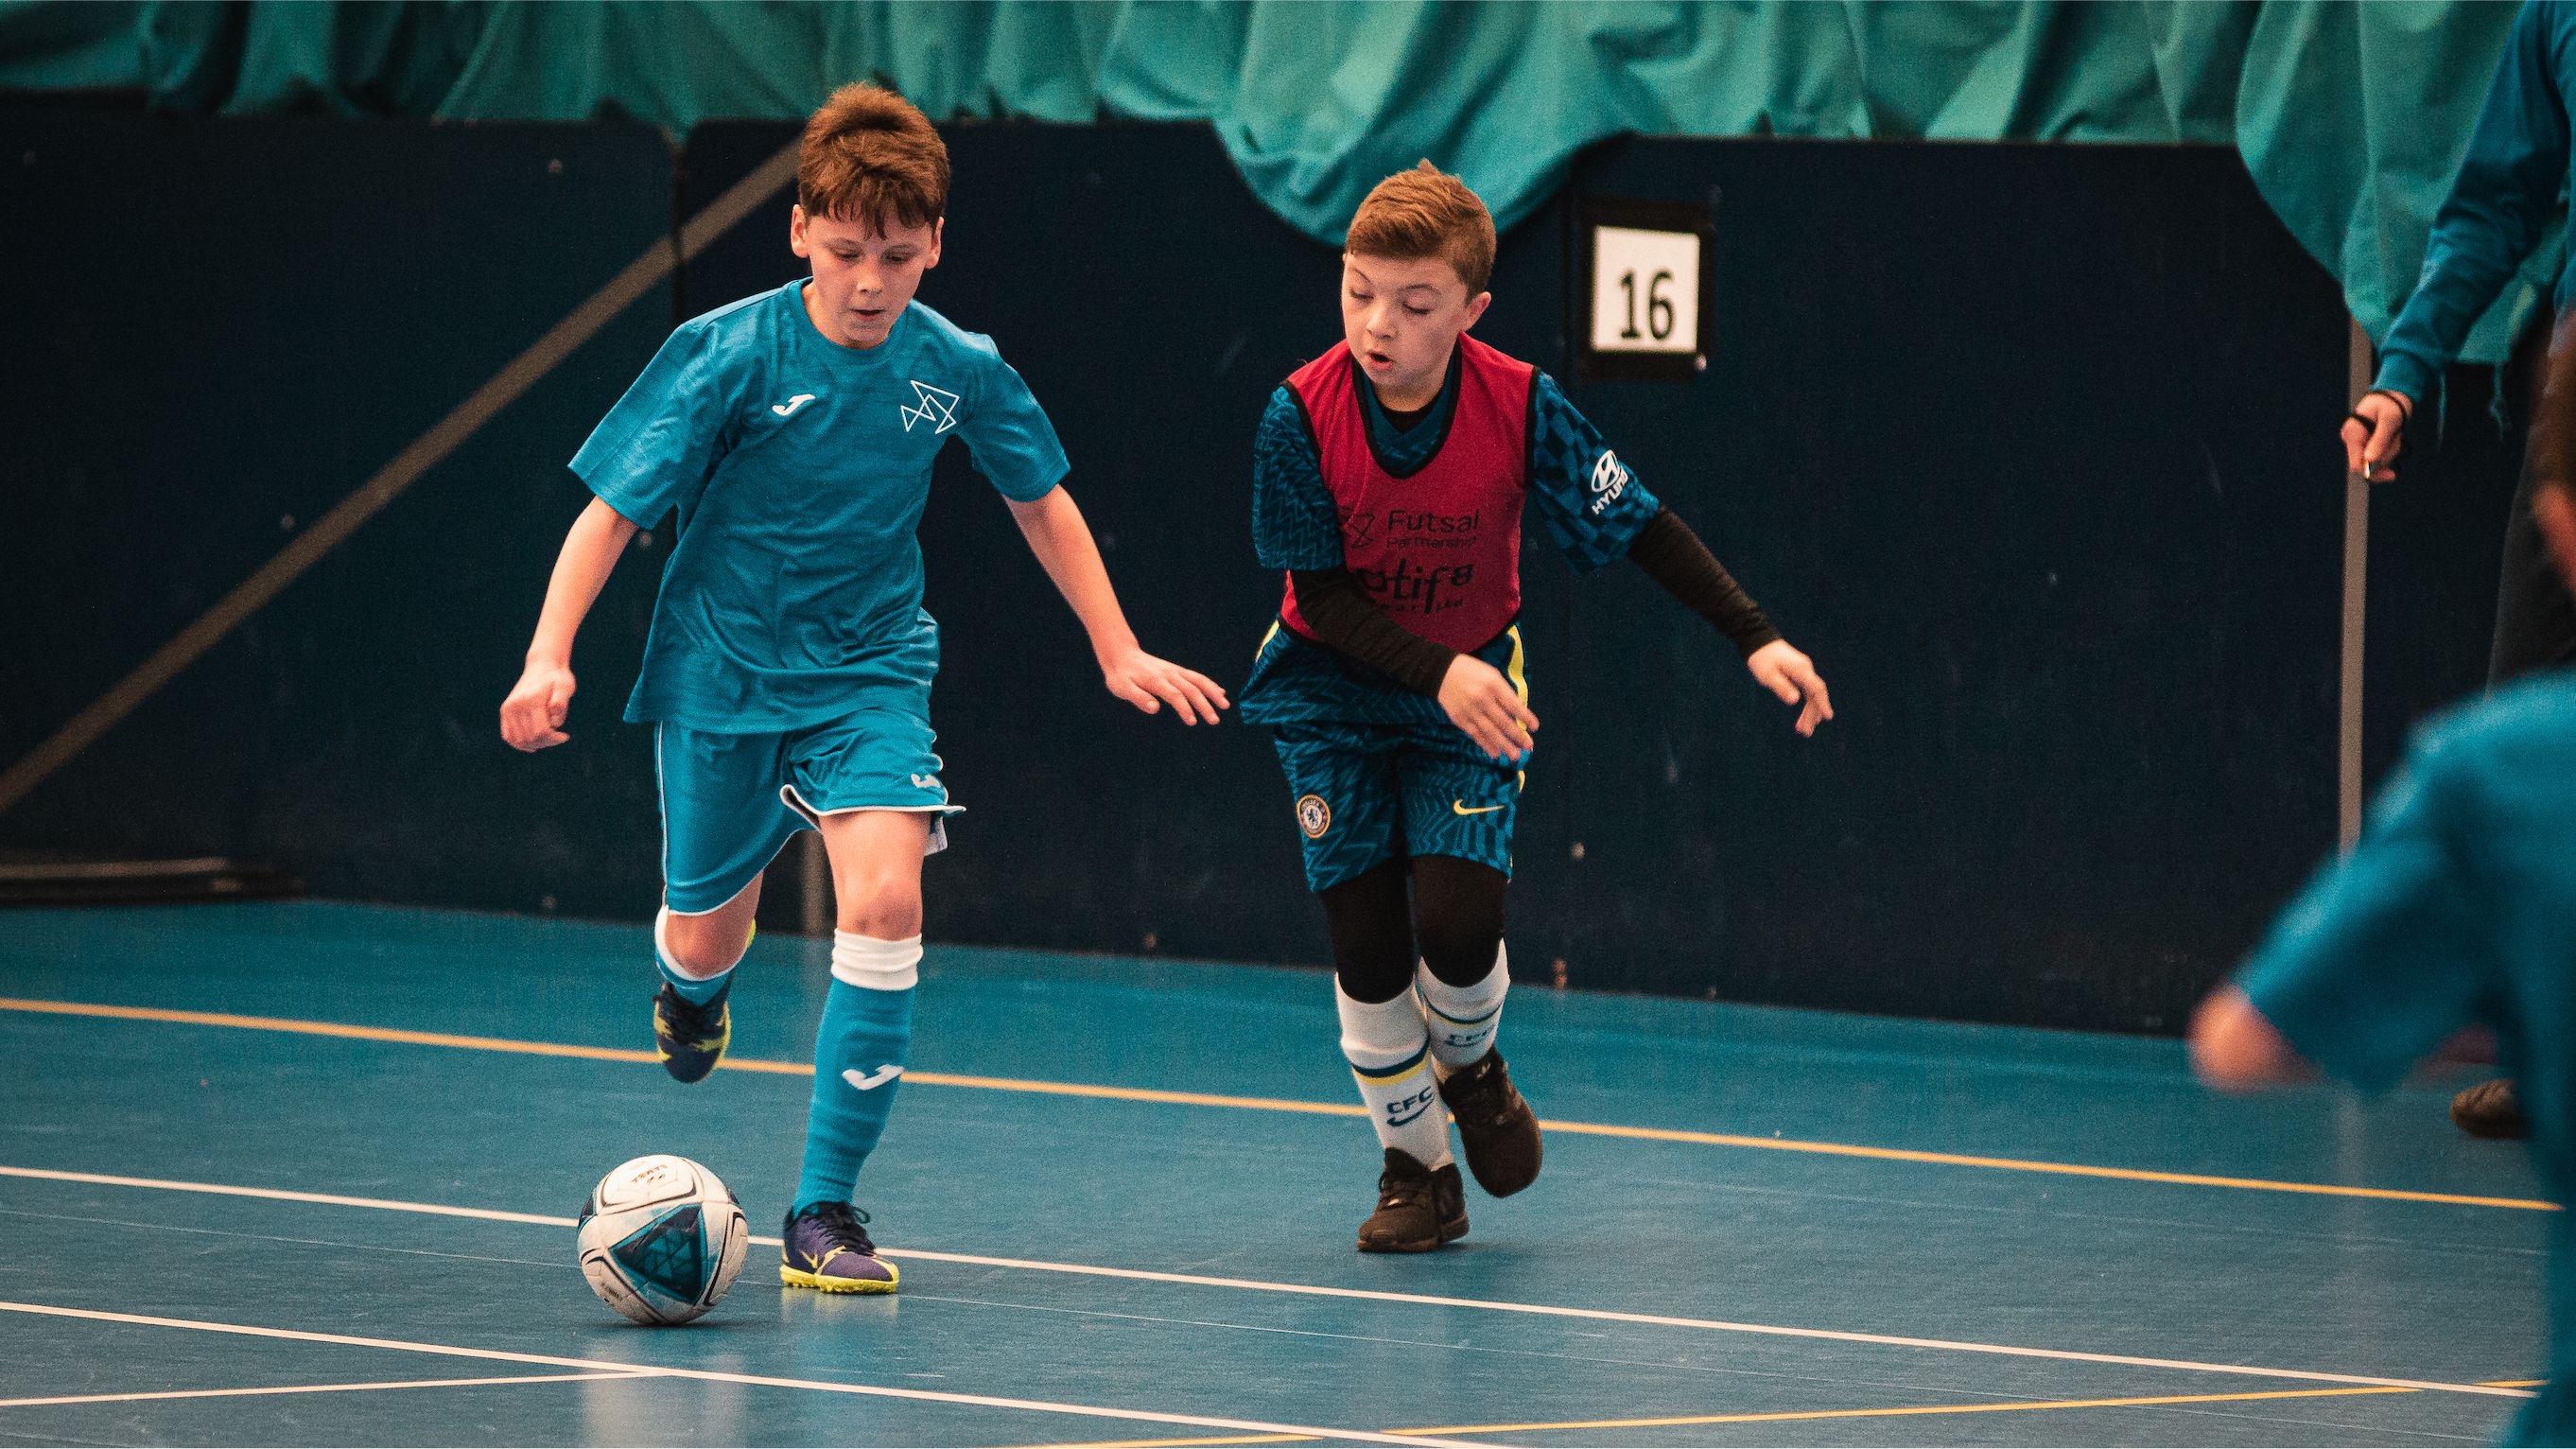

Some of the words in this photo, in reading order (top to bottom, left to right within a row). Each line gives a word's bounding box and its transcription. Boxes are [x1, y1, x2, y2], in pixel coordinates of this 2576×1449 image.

[1618, 269, 1674, 340] 16
[1387, 508, 1480, 532] Futsal
[1386, 1086, 1435, 1114] CFC
